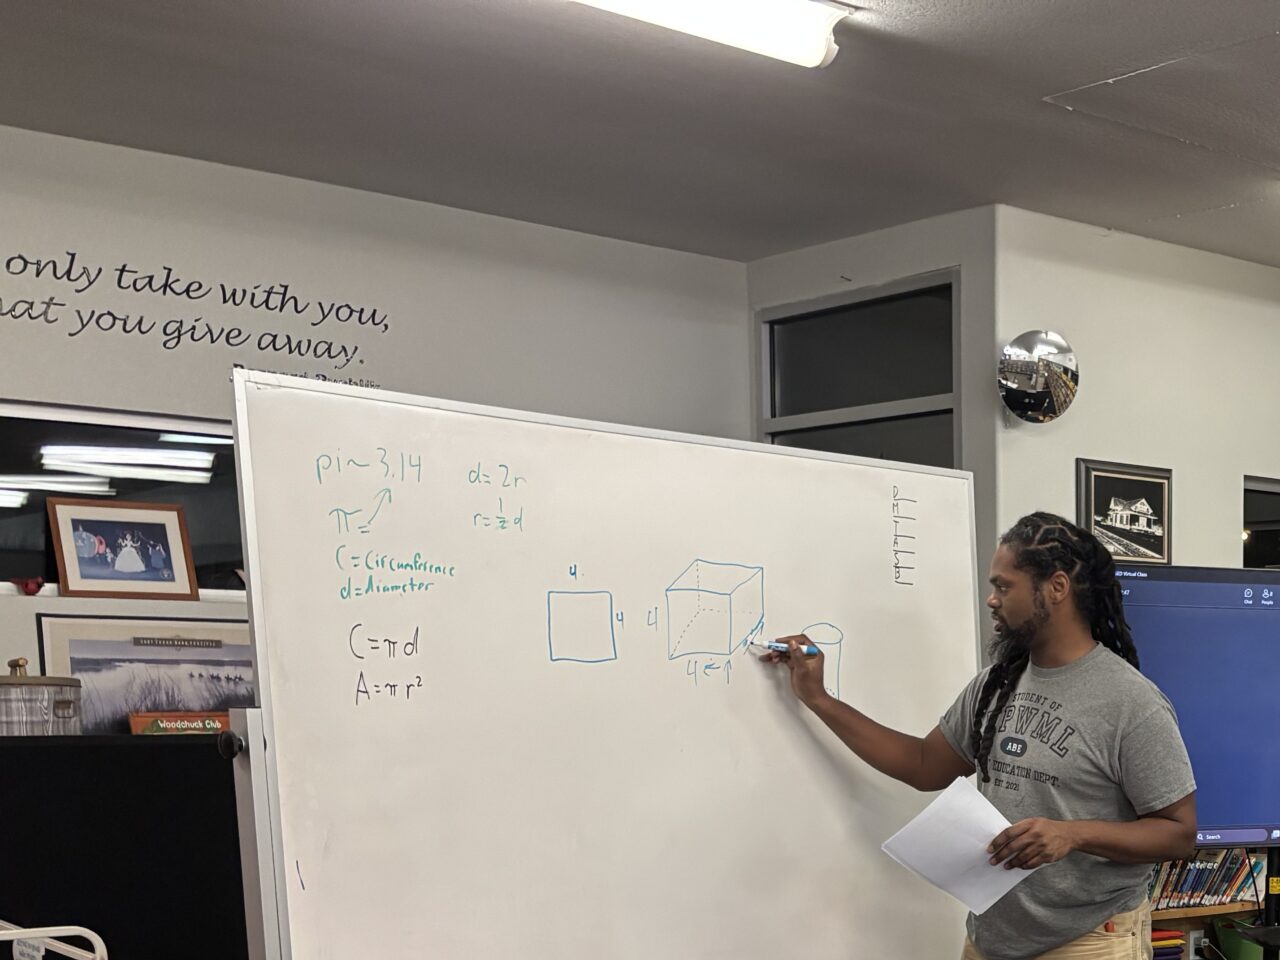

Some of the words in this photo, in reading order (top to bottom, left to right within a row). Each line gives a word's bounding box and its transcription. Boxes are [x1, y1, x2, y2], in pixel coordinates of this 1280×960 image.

[5, 251, 102, 293] only
[114, 263, 212, 300] take
[220, 283, 310, 314] with
[311, 301, 389, 333] you,
[0, 297, 66, 324] at
[68, 309, 156, 337] you
[162, 317, 251, 350] give
[257, 331, 364, 370] away.
[1012, 692, 1048, 706] STUDENT
[1049, 701, 1063, 712] OF
[158, 719, 204, 729] Woodchuck
[205, 718, 222, 729] Club
[987, 705, 1075, 758] PWML
[1006, 742, 1023, 753] ABE
